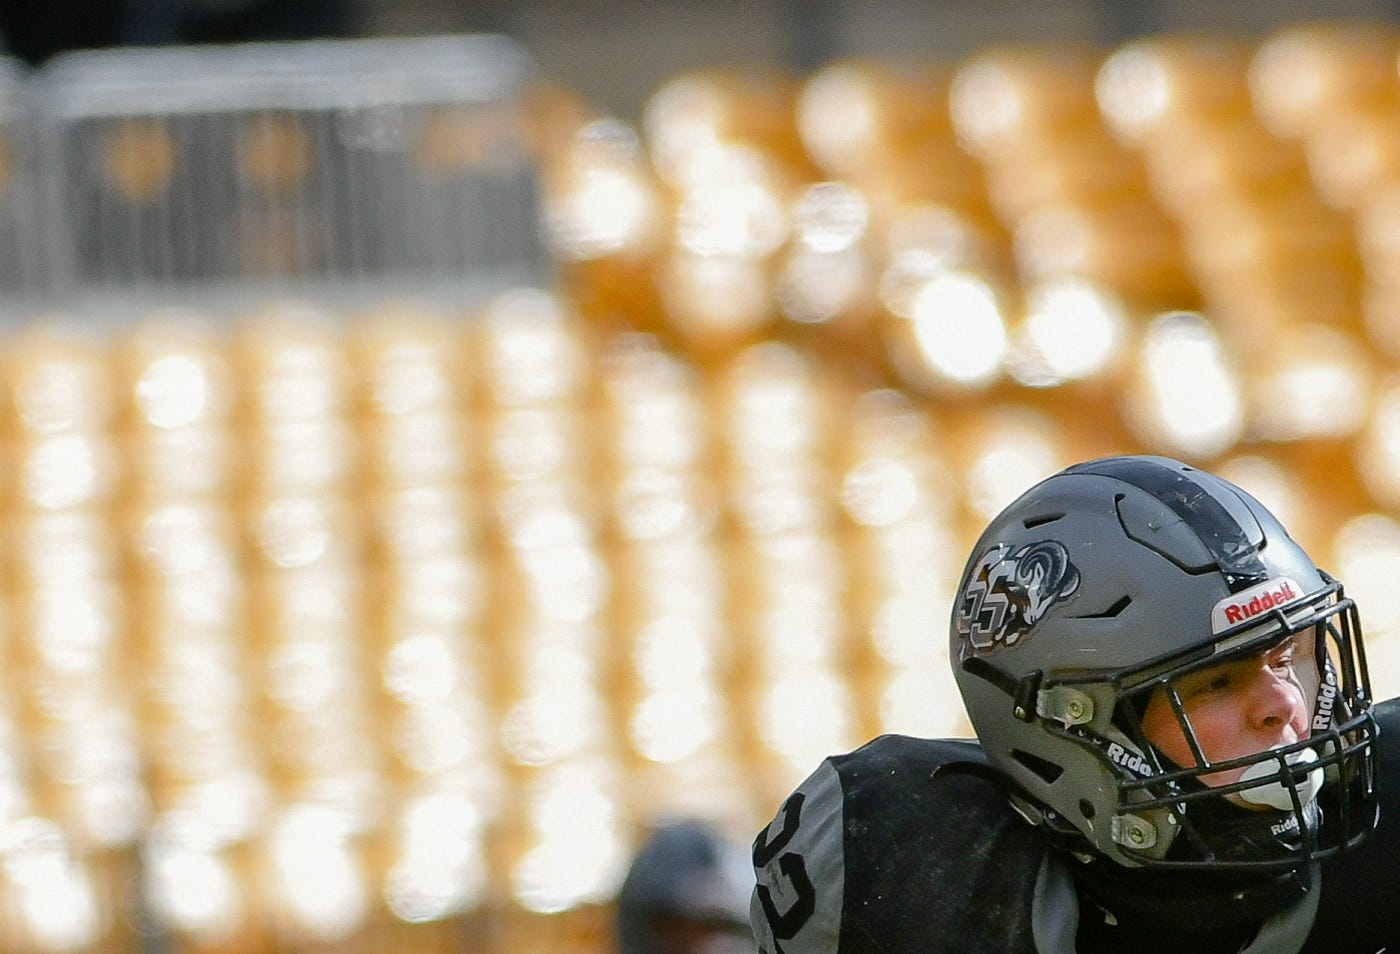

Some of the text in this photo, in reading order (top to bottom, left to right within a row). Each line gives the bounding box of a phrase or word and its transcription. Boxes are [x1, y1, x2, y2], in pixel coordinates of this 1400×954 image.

[1224, 581, 1296, 625] Riddell
[1312, 657, 1337, 730] Ridde
[1107, 742, 1154, 777] Ridd
[1270, 812, 1300, 836] Ridd
